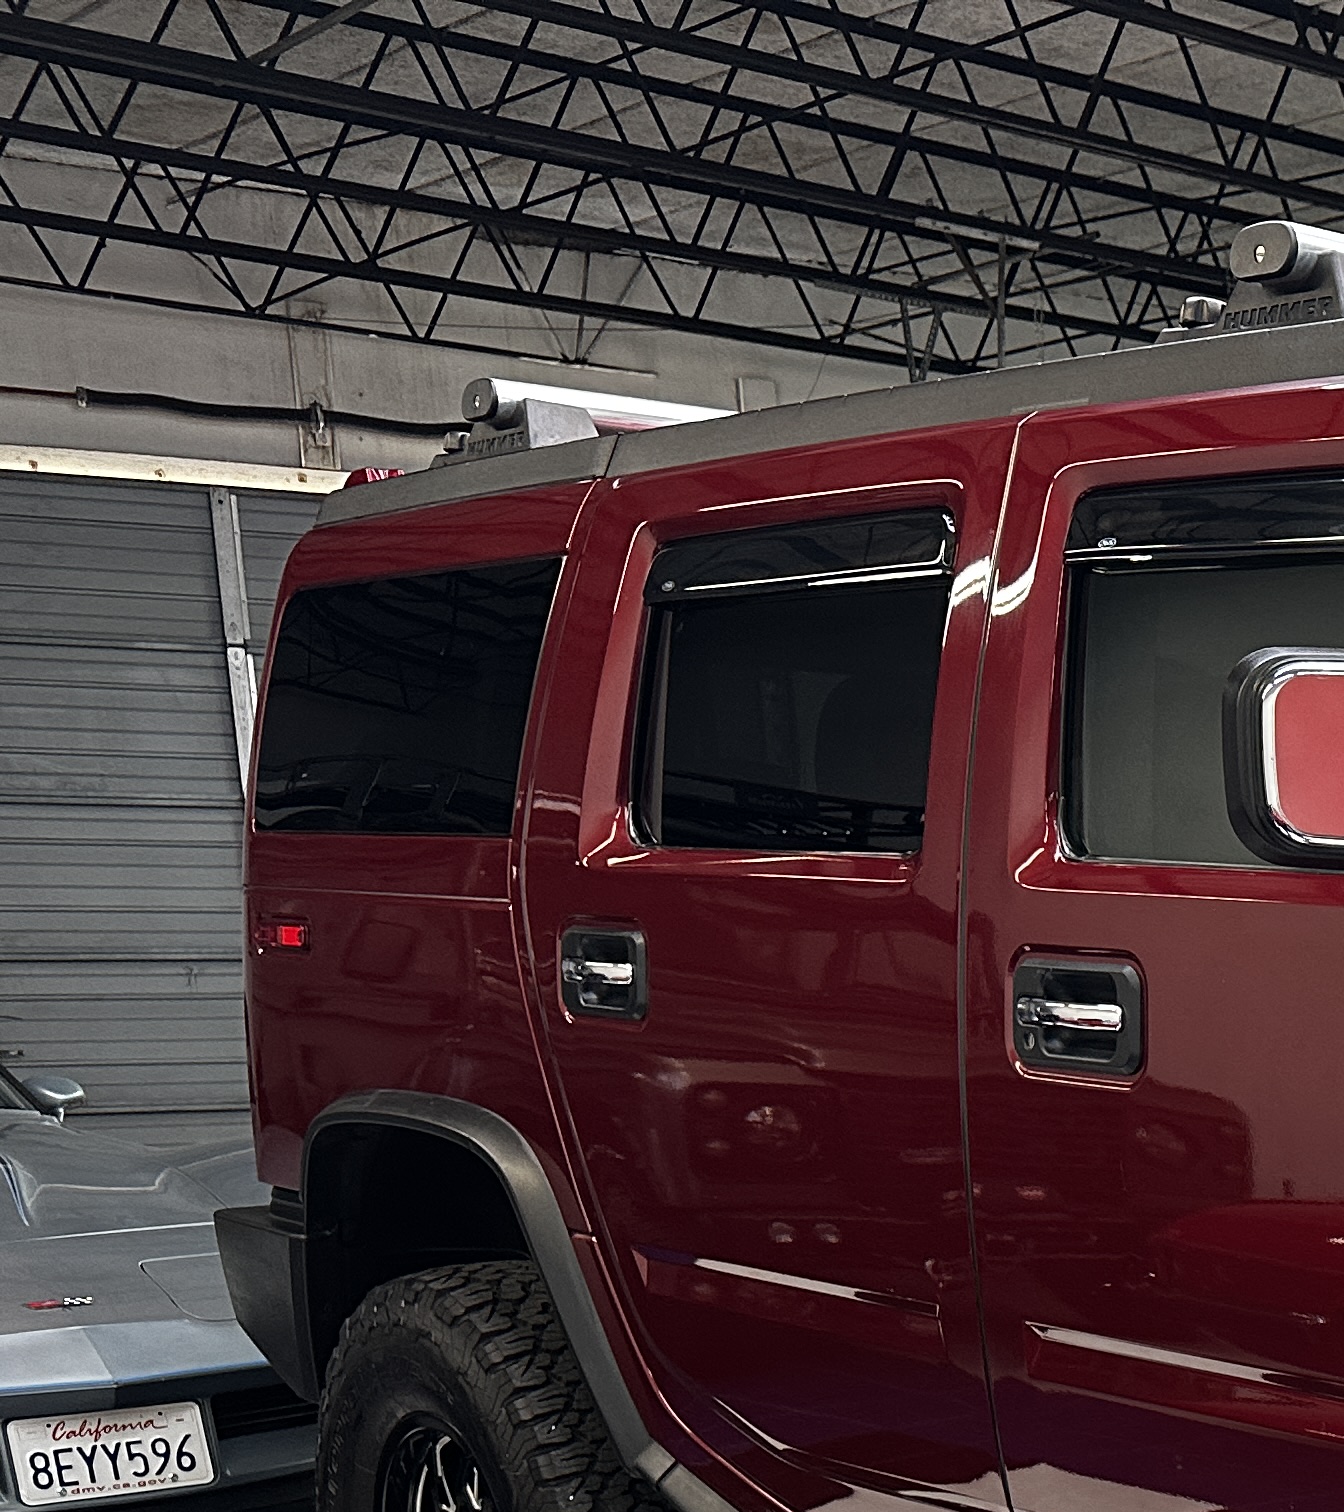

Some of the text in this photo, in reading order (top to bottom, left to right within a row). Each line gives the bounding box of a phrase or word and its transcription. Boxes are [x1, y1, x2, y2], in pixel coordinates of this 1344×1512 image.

[1223, 295, 1334, 330] HUMMER
[51, 1416, 169, 1442] California
[28, 1433, 198, 1491] 8EYY596
[70, 1476, 168, 1496] dmv.ca.gov
